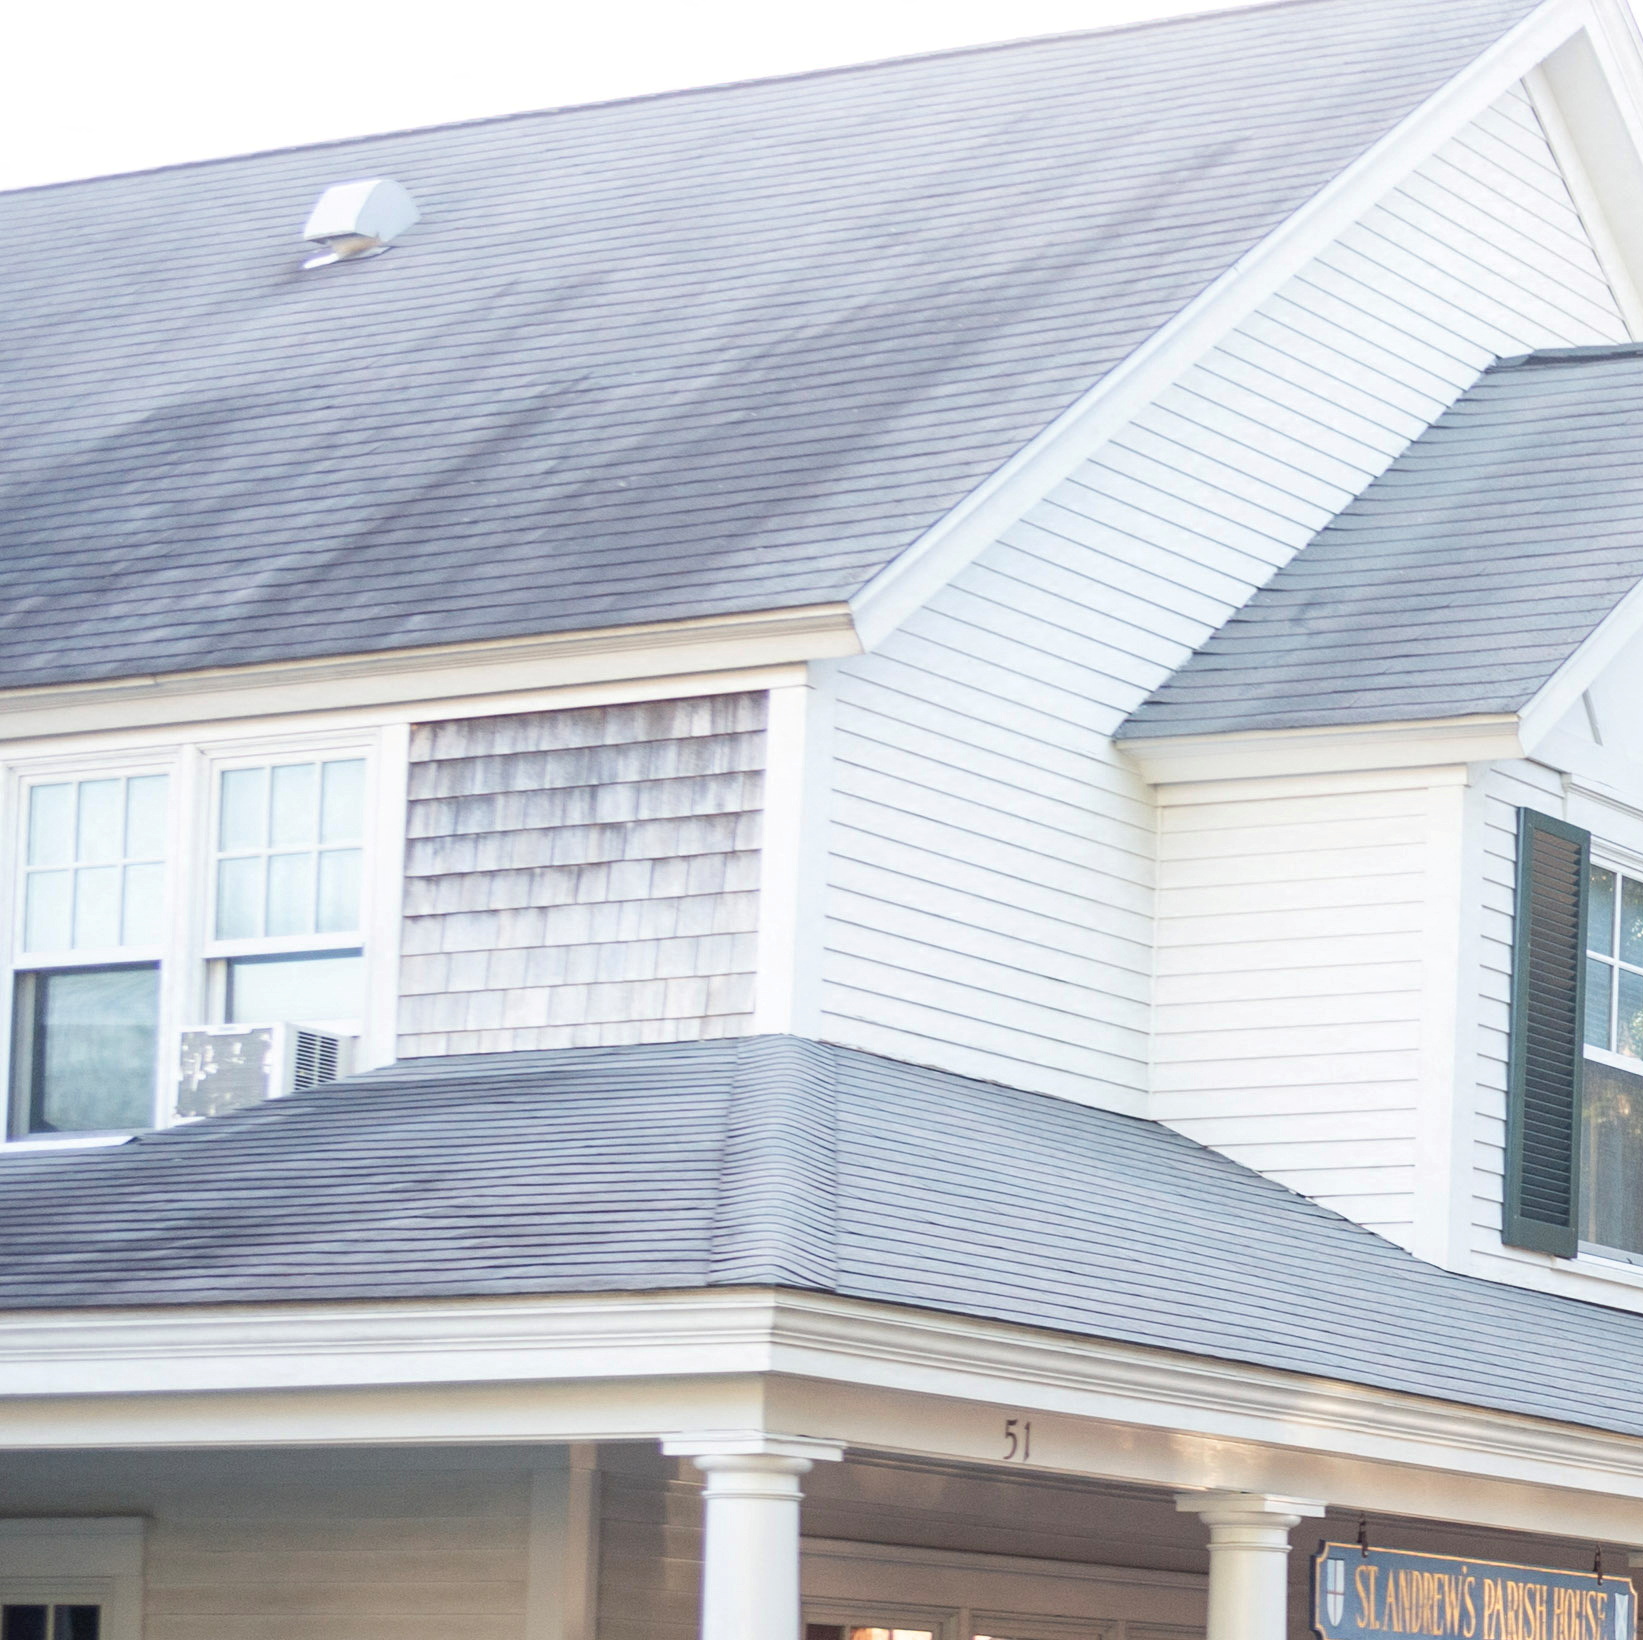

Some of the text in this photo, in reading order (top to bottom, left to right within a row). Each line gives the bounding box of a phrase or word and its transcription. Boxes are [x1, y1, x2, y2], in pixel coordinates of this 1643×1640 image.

[1003, 1419, 1031, 1462] 51
[1354, 1565, 1380, 1628] ST.
[1383, 1566, 1476, 1638] ANDREW'S
